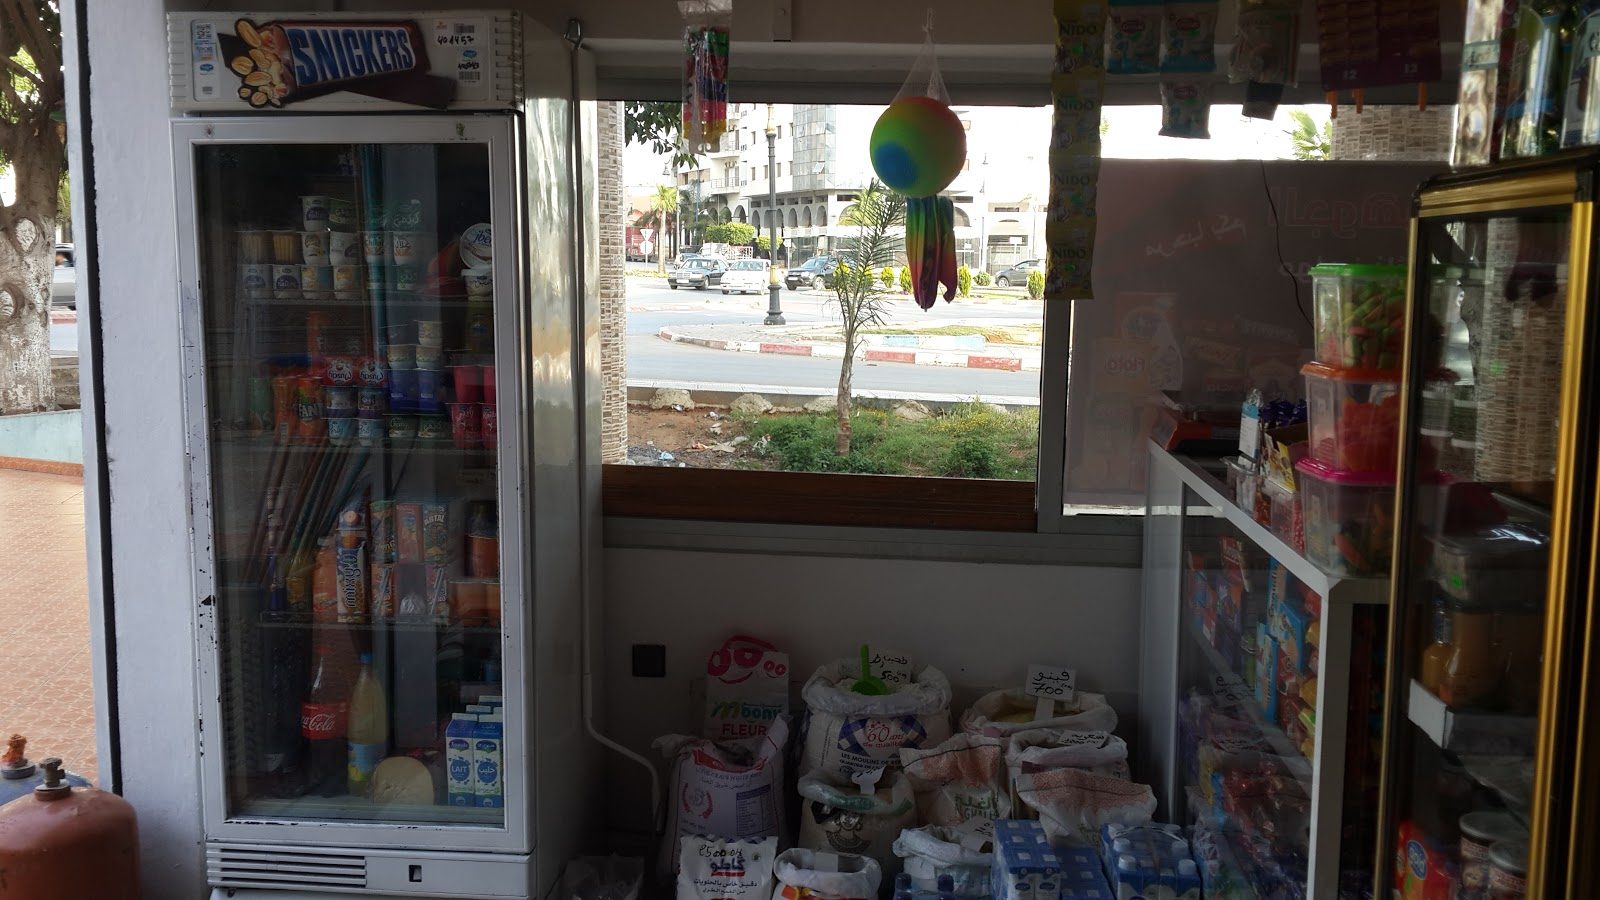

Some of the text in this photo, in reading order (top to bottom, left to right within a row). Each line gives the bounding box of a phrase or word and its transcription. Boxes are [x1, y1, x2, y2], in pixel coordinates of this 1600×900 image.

[1059, 22, 1098, 37] NIDO
[286, 26, 414, 85] SNICKERS
[1057, 98, 1095, 112] NIDO
[1054, 173, 1091, 186] NIDO
[473, 229, 492, 245] jbe
[1051, 246, 1087, 259] NIDO
[1032, 682, 1064, 695] 700
[722, 723, 767, 736] FLEUR
[867, 726, 890, 743] 60
[451, 765, 467, 773] LAIT
